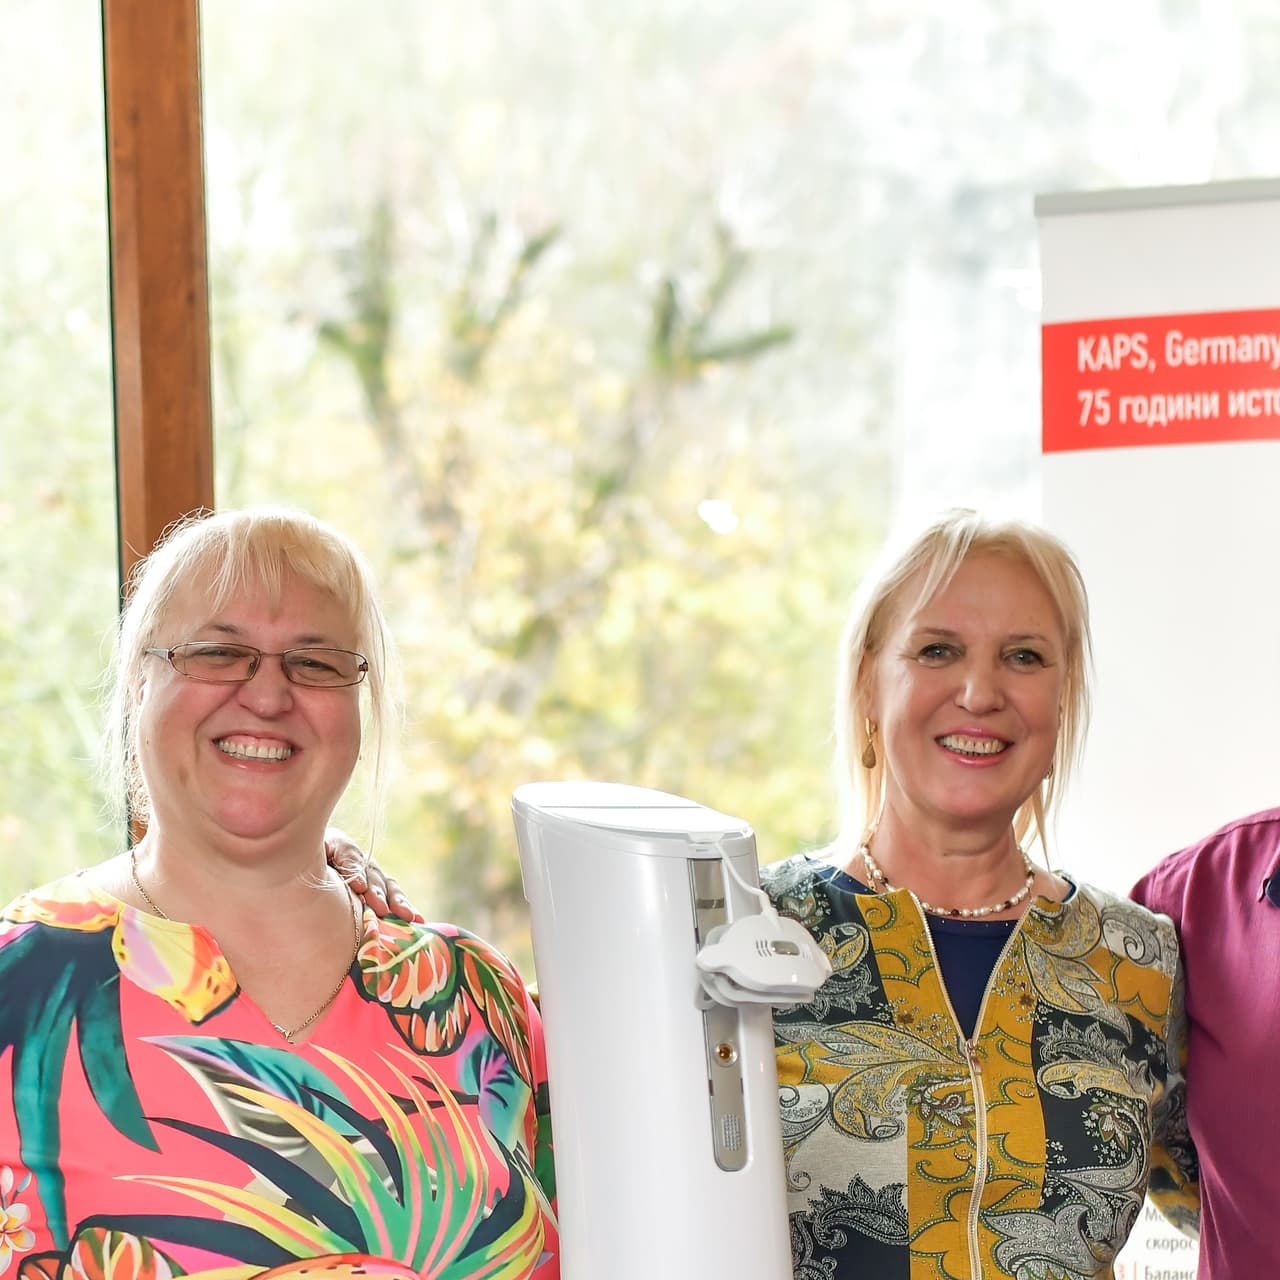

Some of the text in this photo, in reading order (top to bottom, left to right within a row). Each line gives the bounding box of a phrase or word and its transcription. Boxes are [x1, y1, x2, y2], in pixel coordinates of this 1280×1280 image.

[1077, 332, 1157, 373] KAPS,
[1077, 389, 1111, 427] 75
[1119, 391, 1220, 426] години
